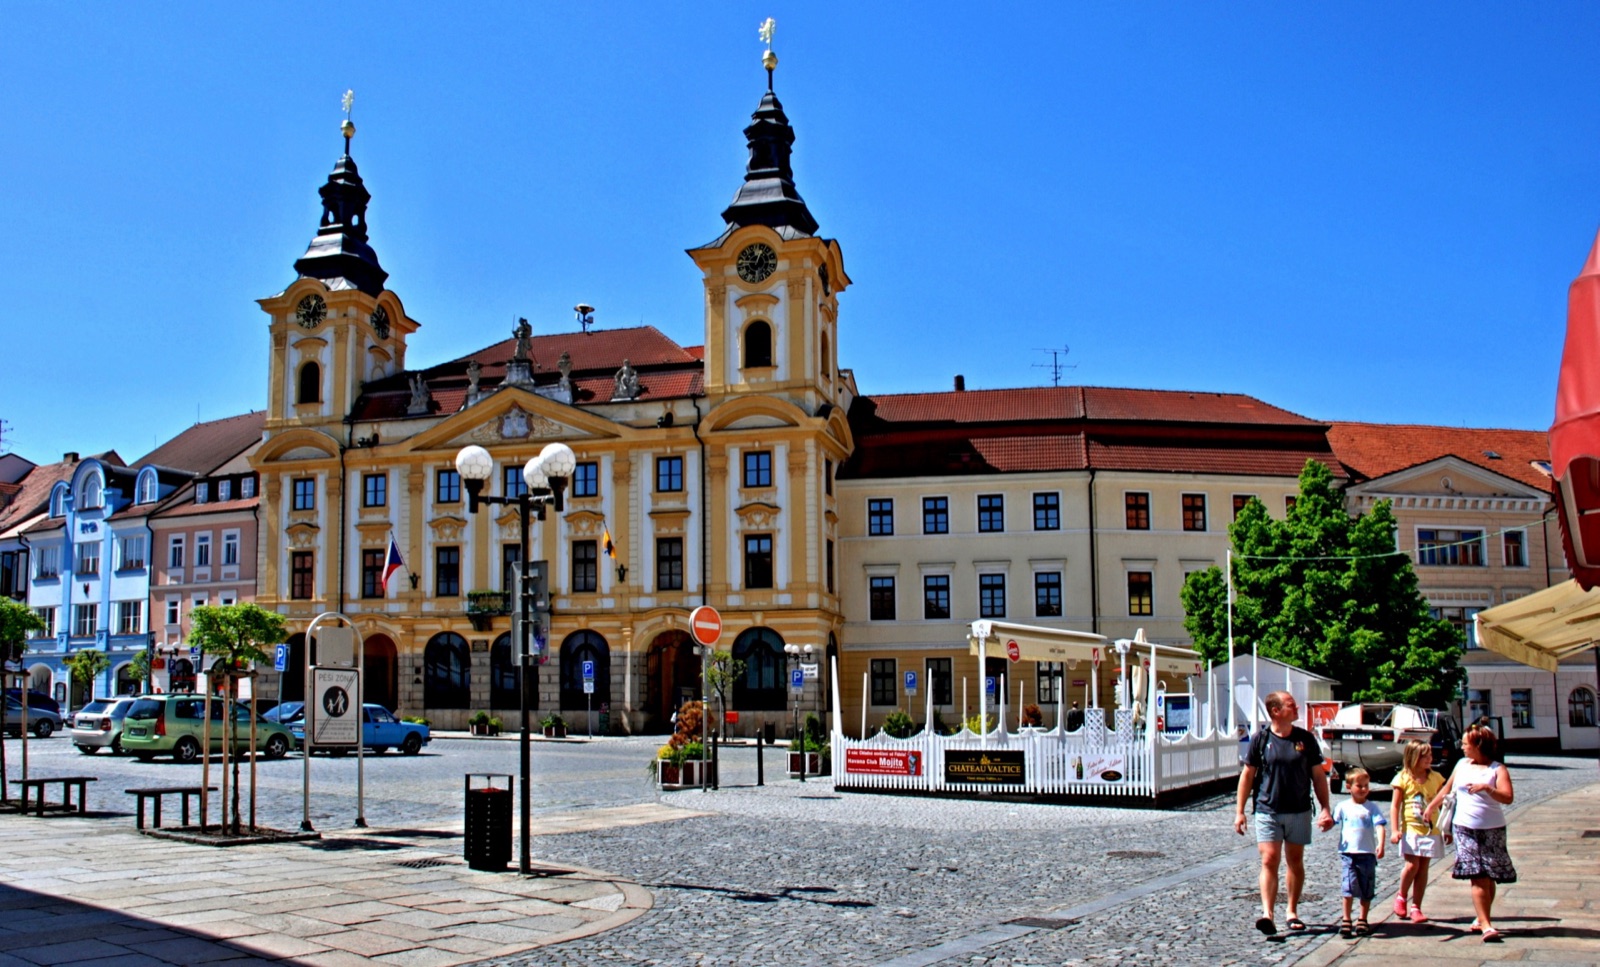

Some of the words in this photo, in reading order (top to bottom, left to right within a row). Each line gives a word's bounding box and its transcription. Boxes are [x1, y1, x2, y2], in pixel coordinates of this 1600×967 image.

[879, 757, 903, 768] Mojito
[948, 764, 987, 773] CHÂTEAU
[987, 765, 1021, 774] VALTICE
